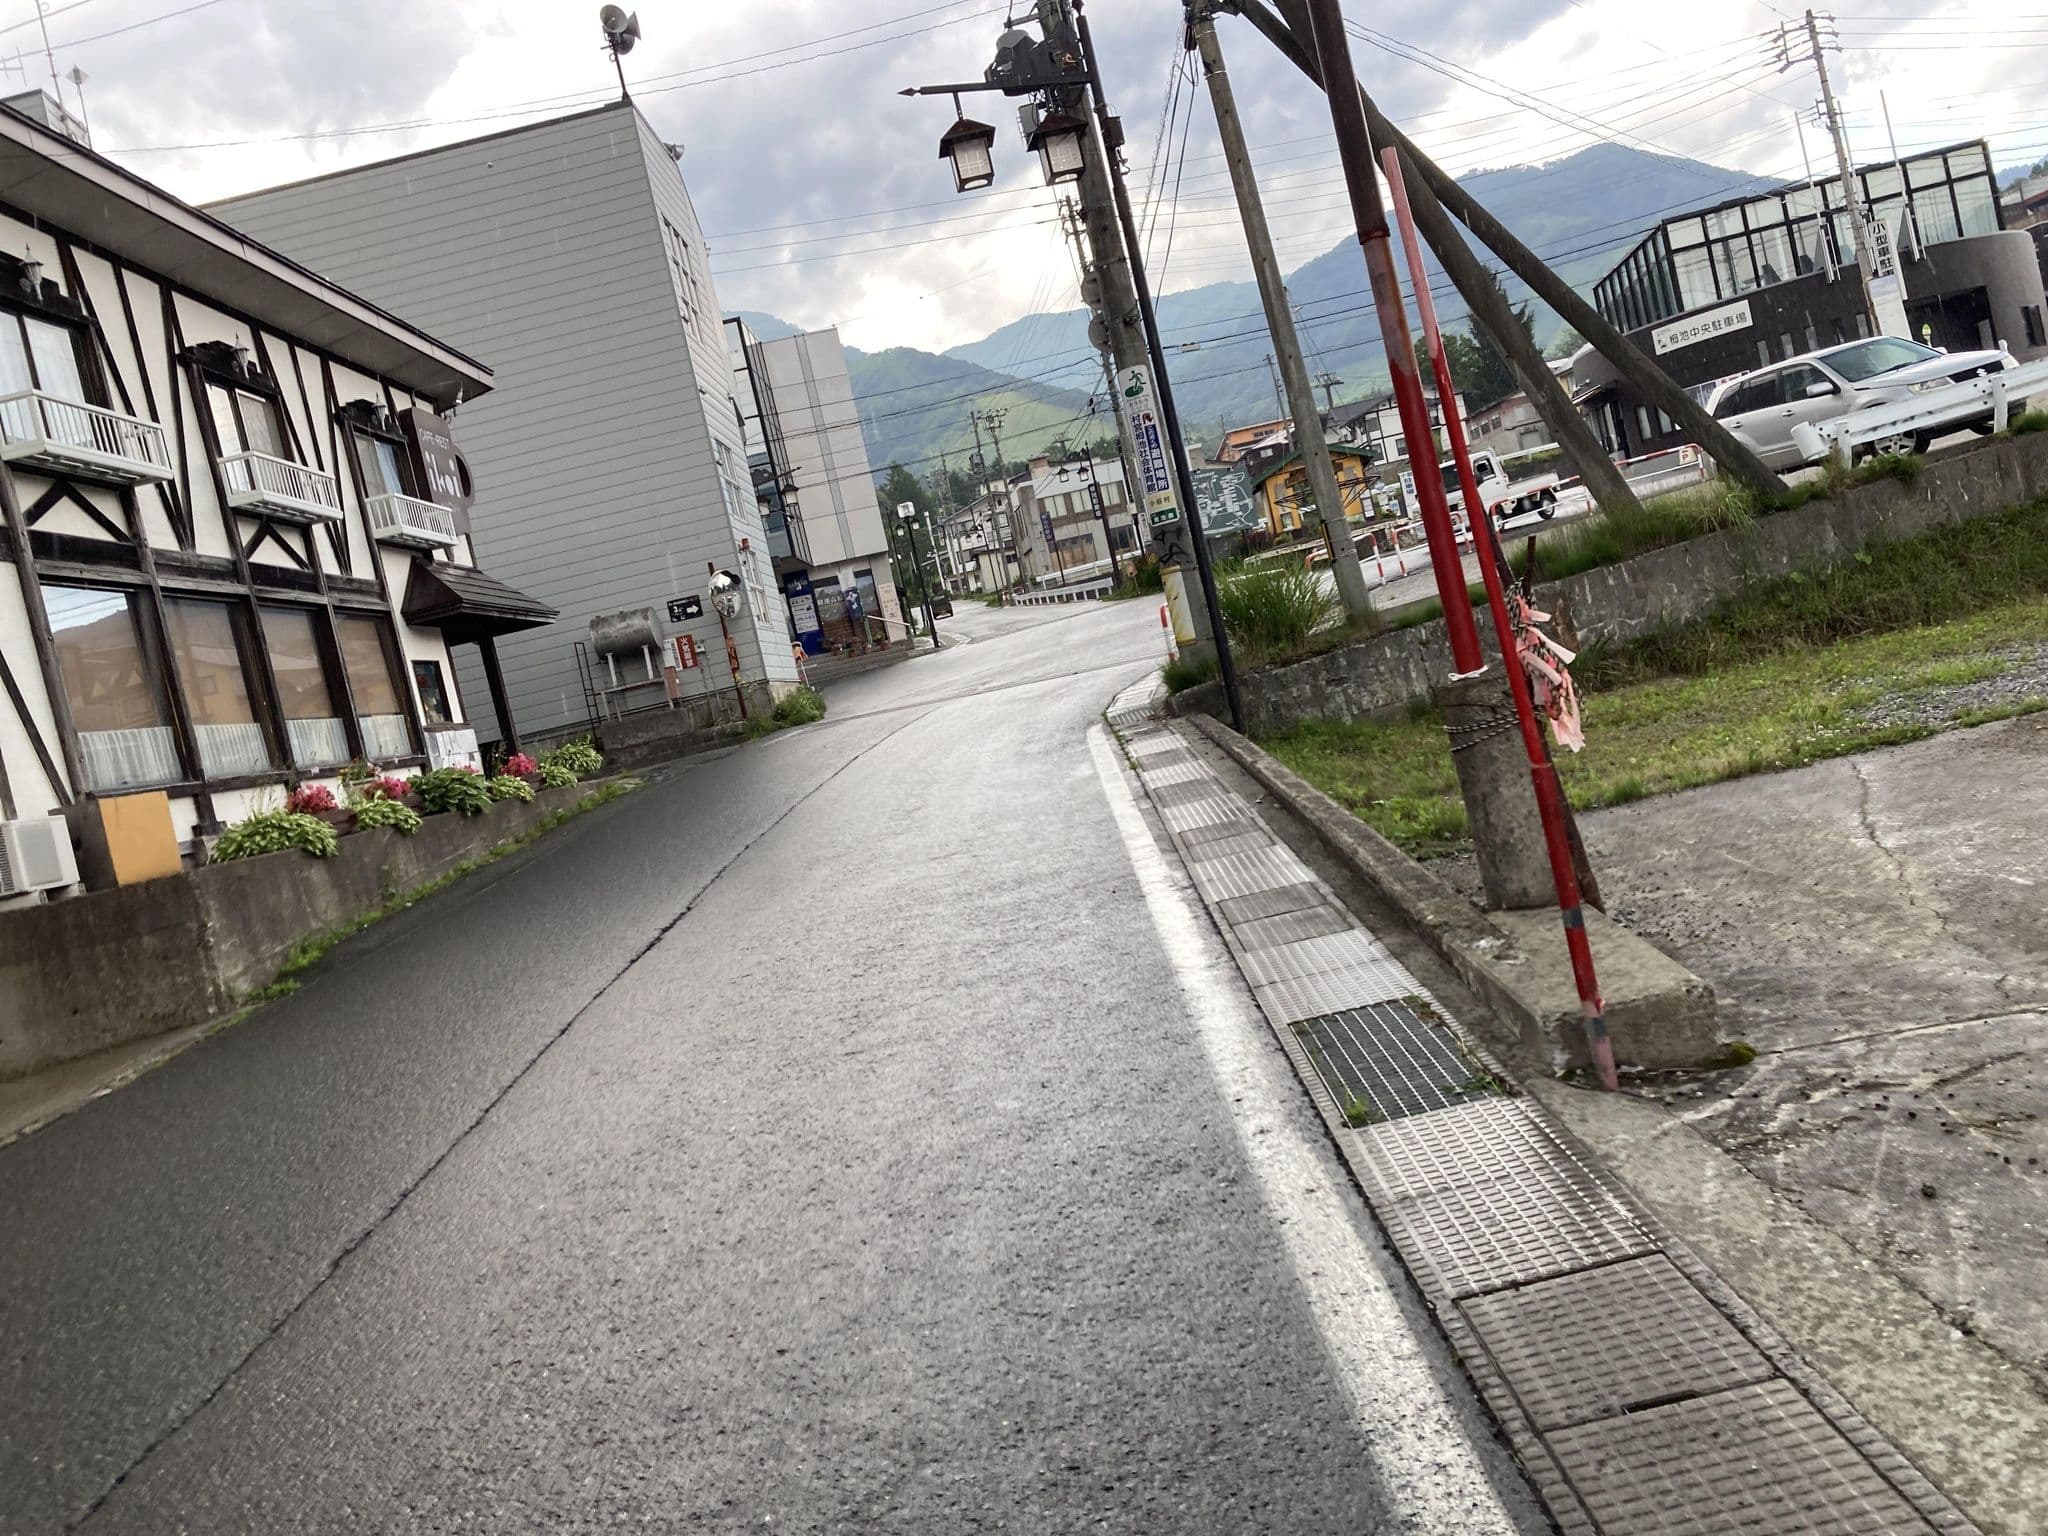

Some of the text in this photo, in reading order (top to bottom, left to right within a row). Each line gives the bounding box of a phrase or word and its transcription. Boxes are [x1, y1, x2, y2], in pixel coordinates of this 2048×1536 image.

[1669, 311, 1748, 345] 栂池中央駐車場
[424, 450, 461, 498] ikoi
